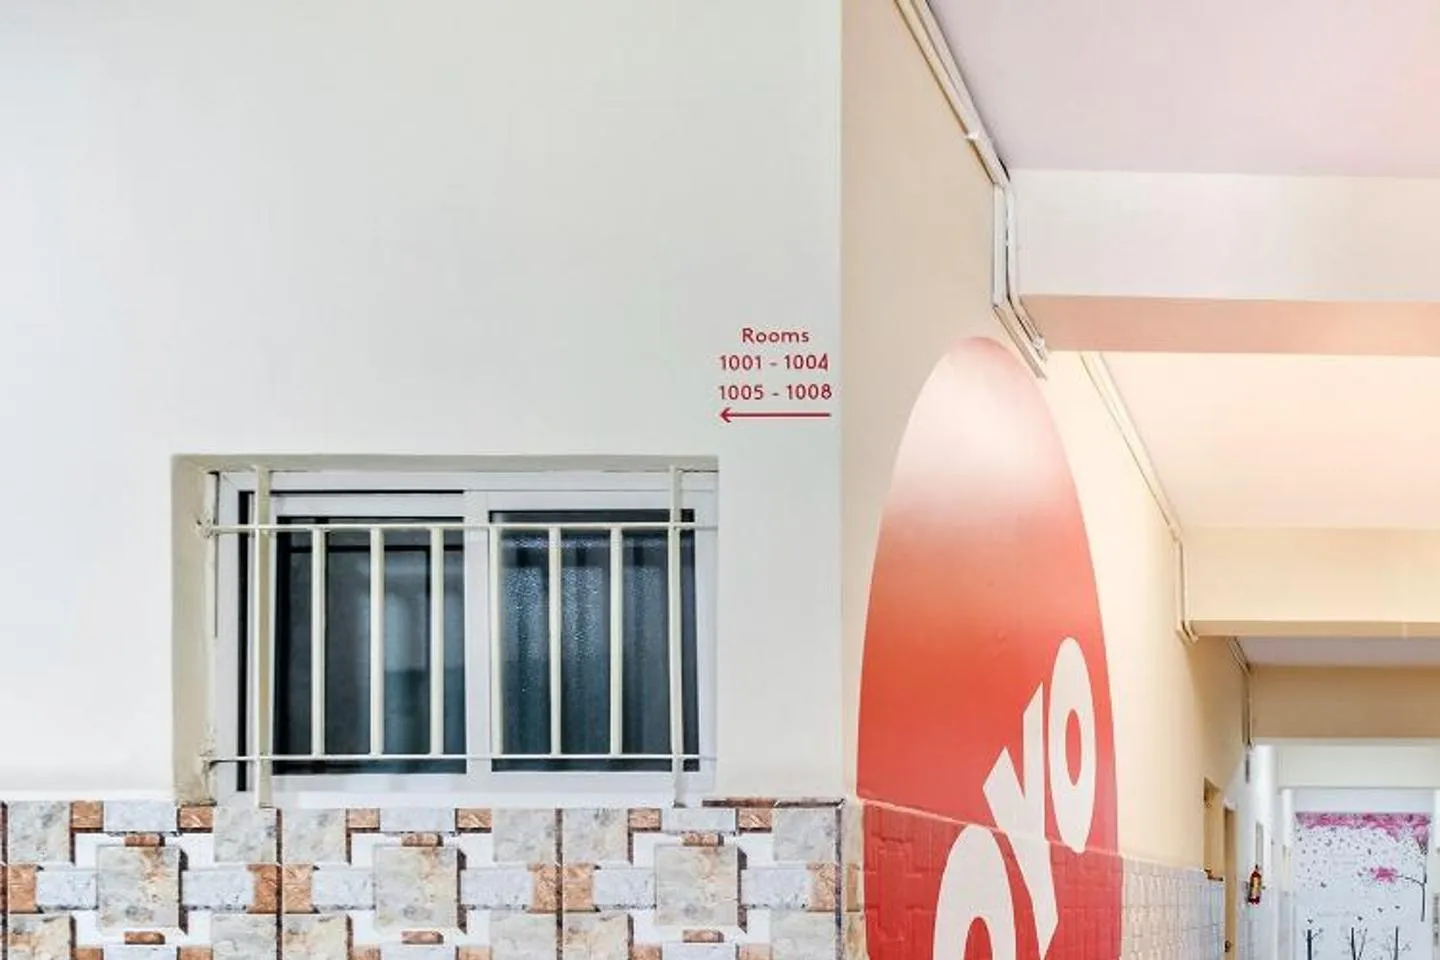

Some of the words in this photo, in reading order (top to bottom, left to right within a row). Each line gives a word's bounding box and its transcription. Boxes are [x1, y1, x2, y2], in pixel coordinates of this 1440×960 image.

[742, 327, 810, 343] Rooms
[720, 354, 762, 371] 1001
[784, 353, 829, 371] 1004
[719, 384, 764, 400] 1005
[786, 383, 832, 400] 1008
